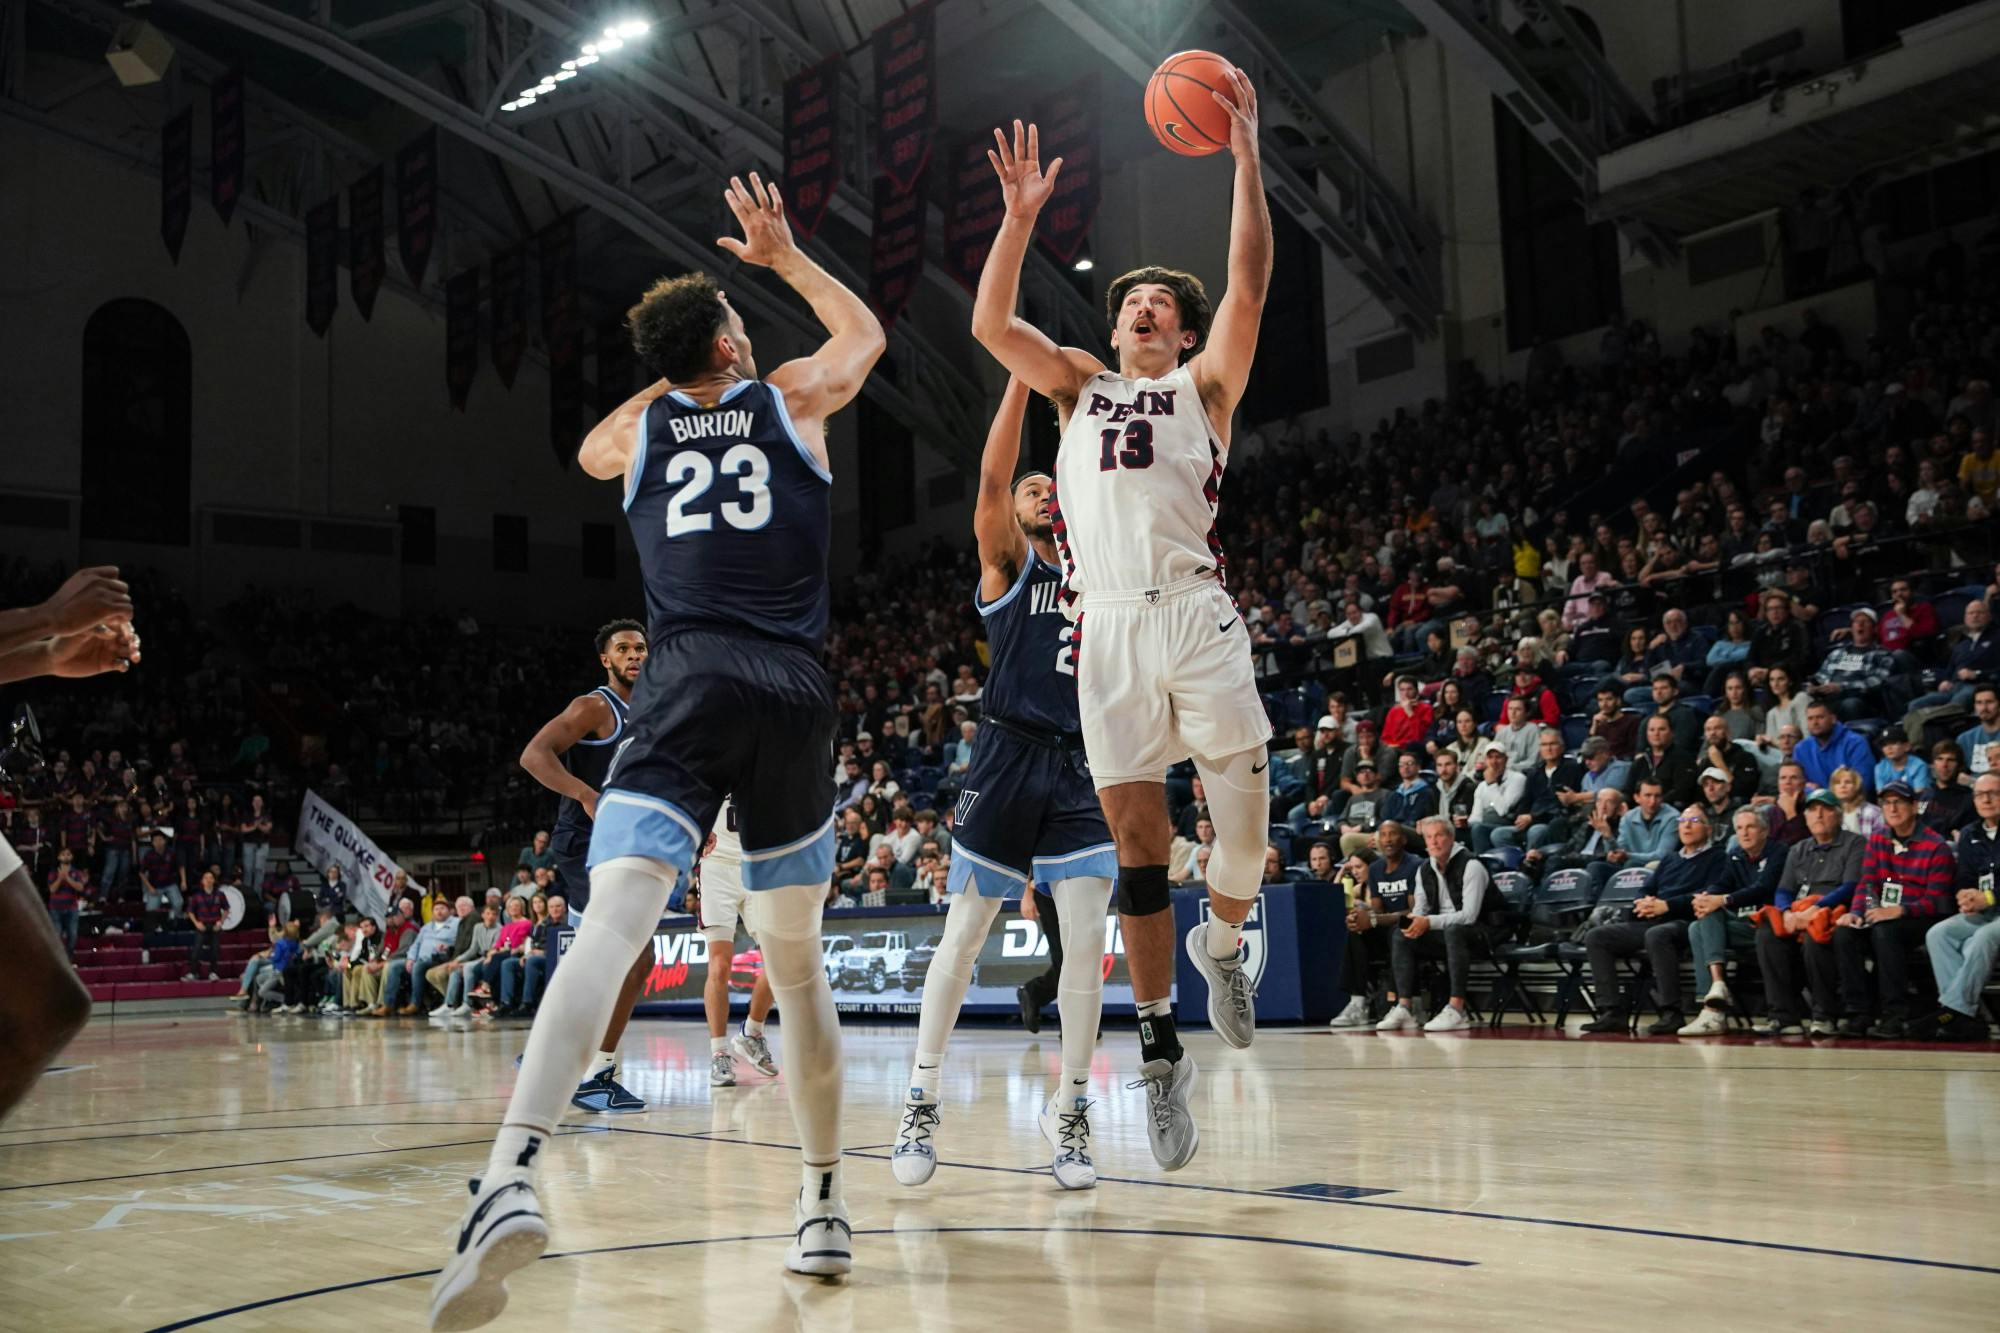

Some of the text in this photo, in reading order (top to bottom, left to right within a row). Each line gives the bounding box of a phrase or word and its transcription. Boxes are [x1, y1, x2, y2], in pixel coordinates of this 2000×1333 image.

[1087, 390, 1176, 423] PENN
[669, 410, 754, 443] BURTON
[1099, 419, 1154, 472] 13
[666, 444, 773, 537] 23
[1030, 581, 1063, 615] VIL
[310, 805, 334, 834] THE
[335, 826, 375, 870] QUAKE
[1378, 879, 1408, 893] PENN
[643, 958, 689, 996] Auto
[838, 1003, 921, 1014] COURT AT THE PALEST
